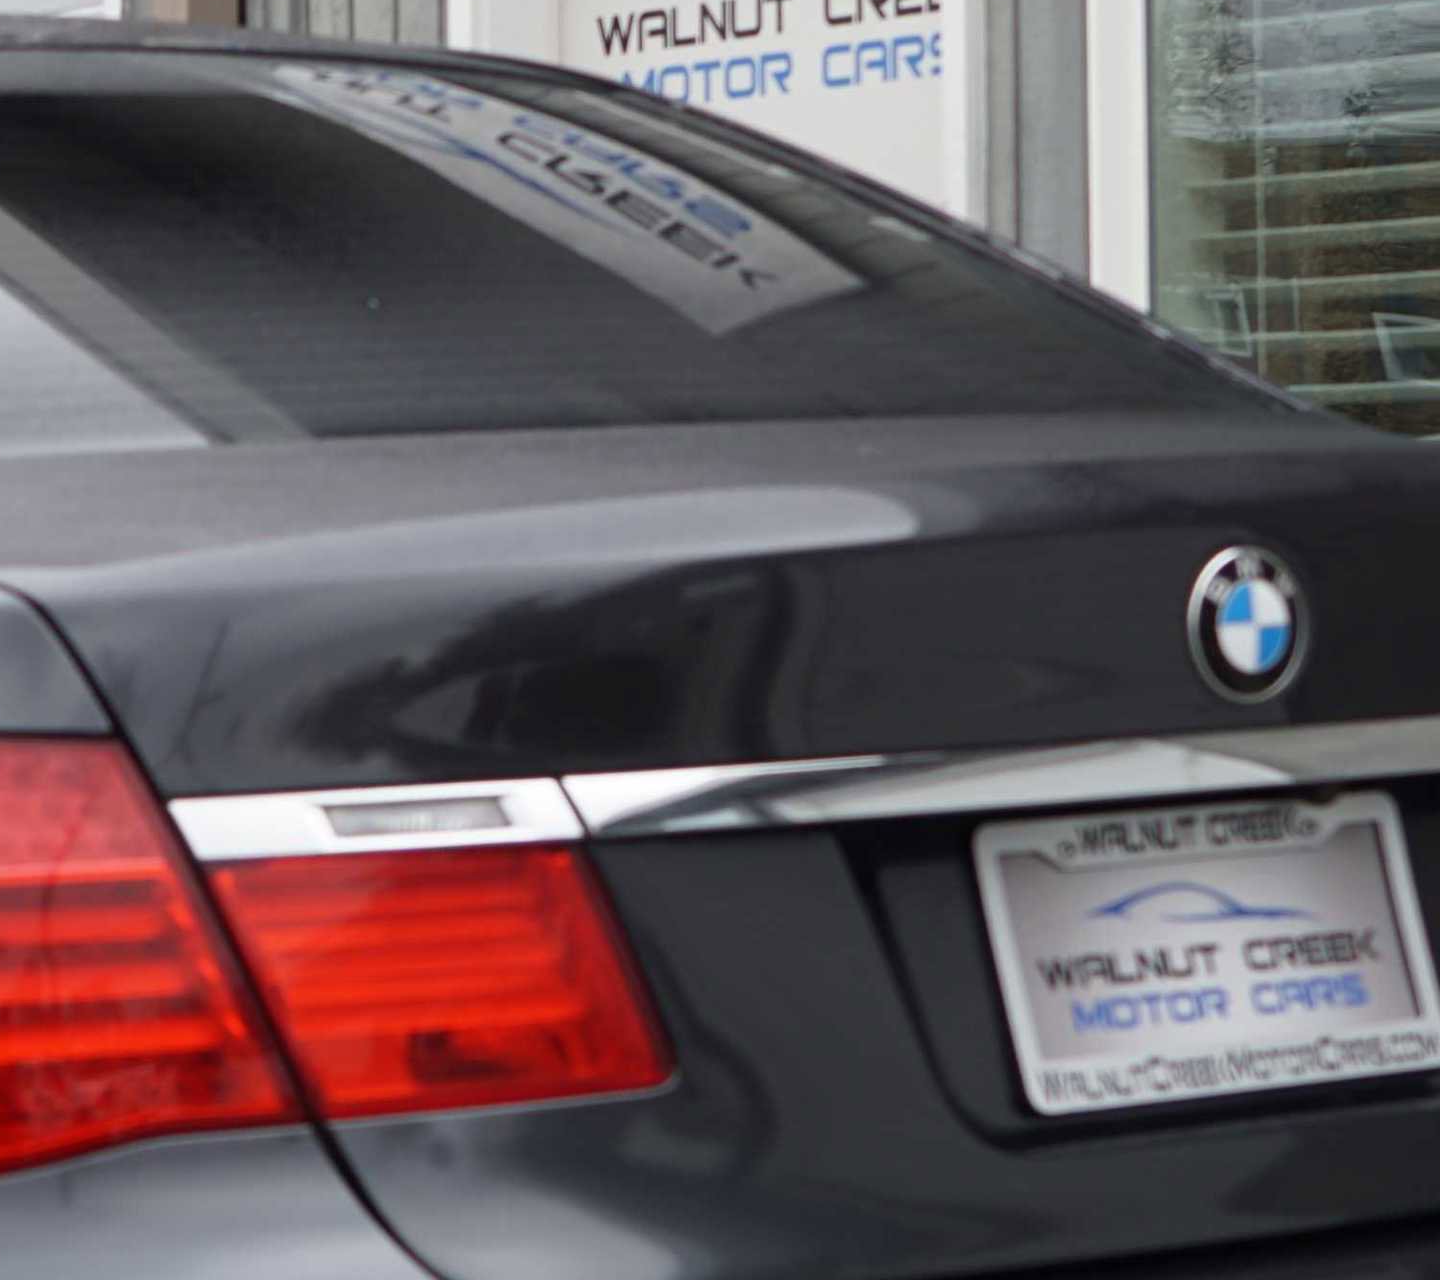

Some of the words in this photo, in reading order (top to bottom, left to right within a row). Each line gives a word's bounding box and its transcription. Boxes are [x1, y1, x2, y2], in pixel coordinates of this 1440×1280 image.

[1037, 943, 1219, 992] WALNUT
[1243, 929, 1379, 972] CREEK
[1072, 989, 1228, 1031] MOTOR
[1251, 972, 1371, 1016] CARS
